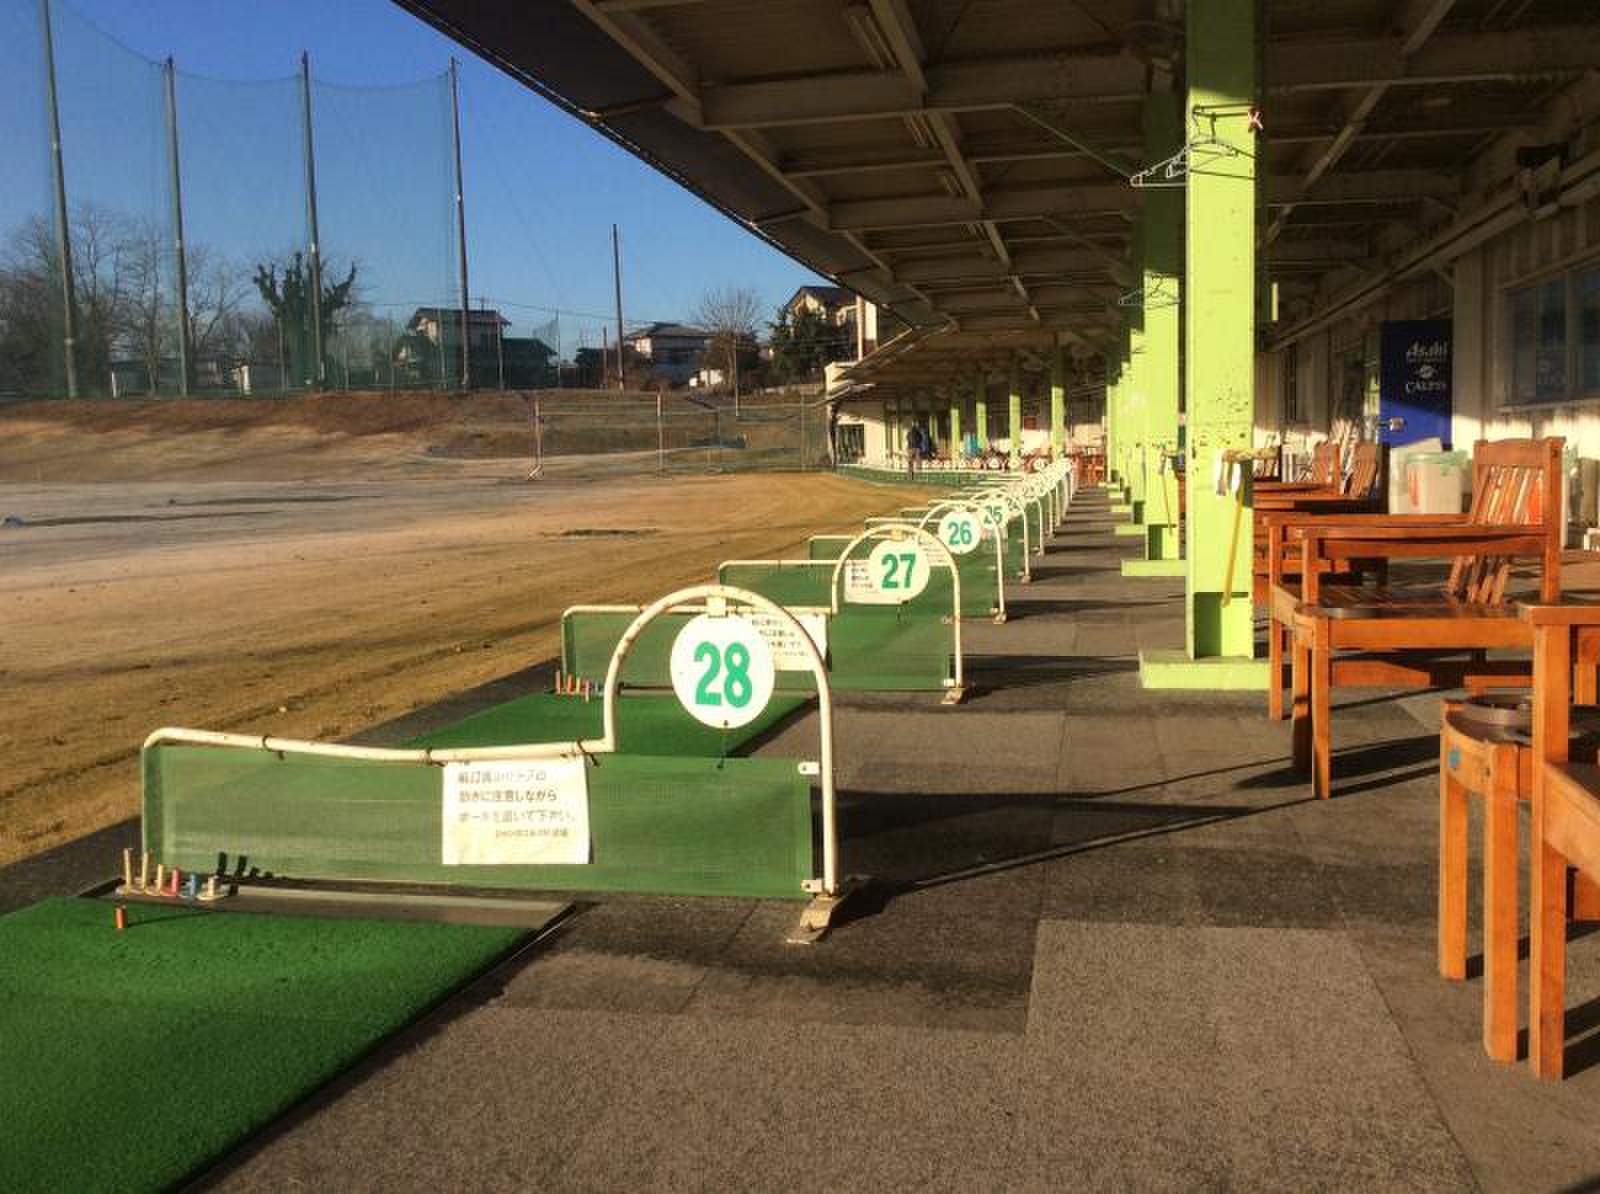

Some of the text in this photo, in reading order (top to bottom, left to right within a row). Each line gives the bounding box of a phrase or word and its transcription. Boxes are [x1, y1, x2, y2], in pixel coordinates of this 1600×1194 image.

[947, 521, 973, 545] 26
[881, 552, 917, 589] 27
[693, 640, 753, 708] 28
